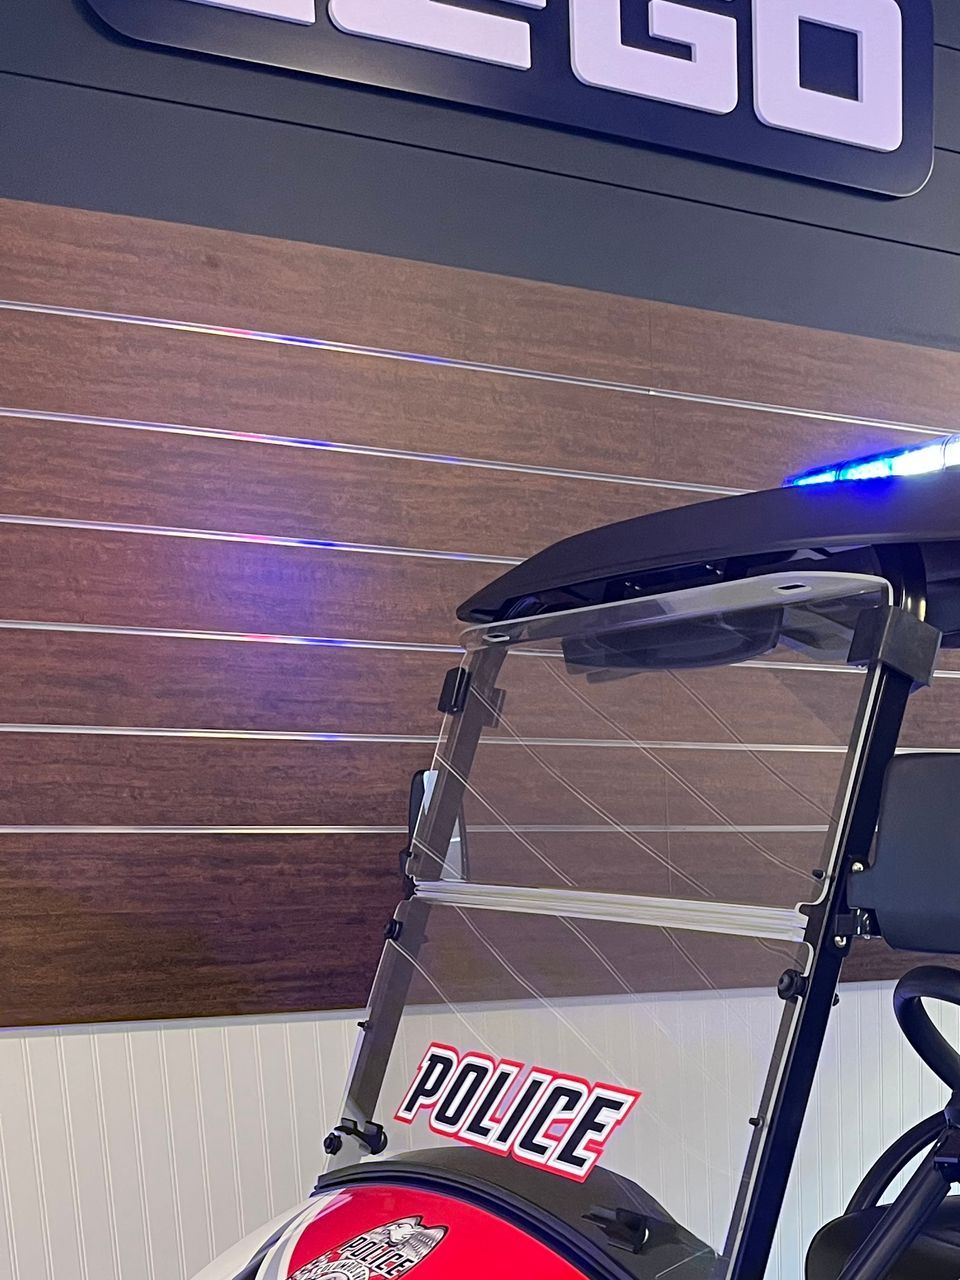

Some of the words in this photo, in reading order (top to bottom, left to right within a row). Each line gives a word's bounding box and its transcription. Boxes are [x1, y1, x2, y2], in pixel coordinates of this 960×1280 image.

[183, 0, 902, 153] GO
[397, 1045, 637, 1178] POLICE
[339, 1236, 415, 1279] POLICE
